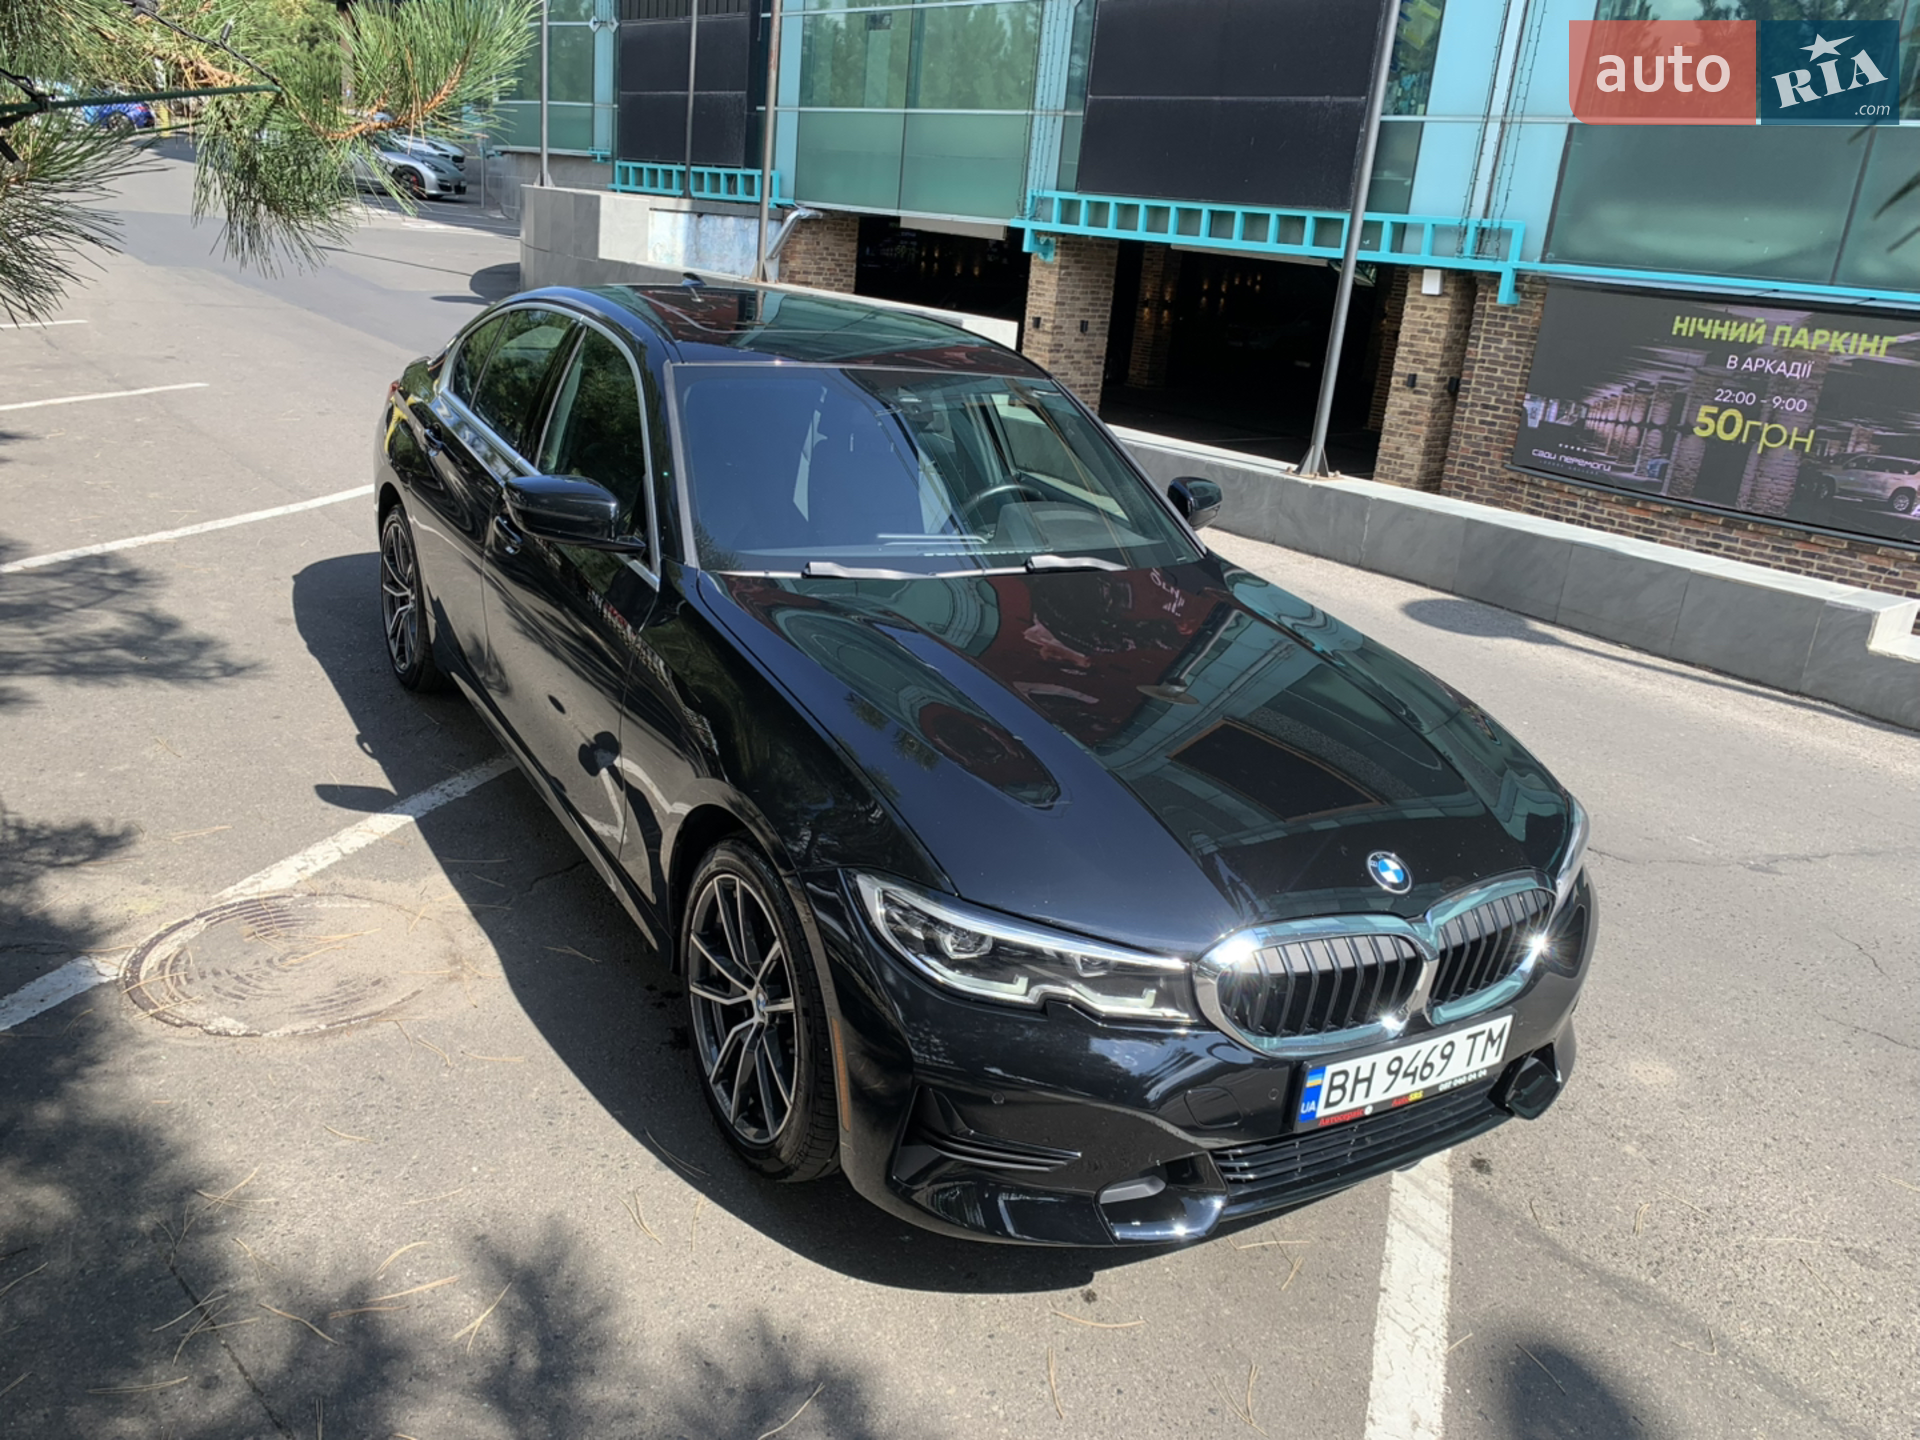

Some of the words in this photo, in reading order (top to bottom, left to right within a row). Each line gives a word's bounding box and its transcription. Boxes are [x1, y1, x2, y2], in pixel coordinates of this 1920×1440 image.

[1671, 314, 1765, 346] НІЧНИЙ
[1771, 324, 1898, 359] ПАРКІНГ
[1726, 354, 1739, 371] В
[1741, 357, 1814, 380] АРКАДІЇ
[1713, 388, 1757, 407] 22:00
[1772, 395, 1808, 413] 9:00
[1692, 404, 1816, 455] 50грн
[1323, 1062, 1377, 1110] BH
[1382, 1040, 1456, 1095] 9469
[1466, 1022, 1508, 1067] TM
[1301, 1101, 1317, 1114] UA
